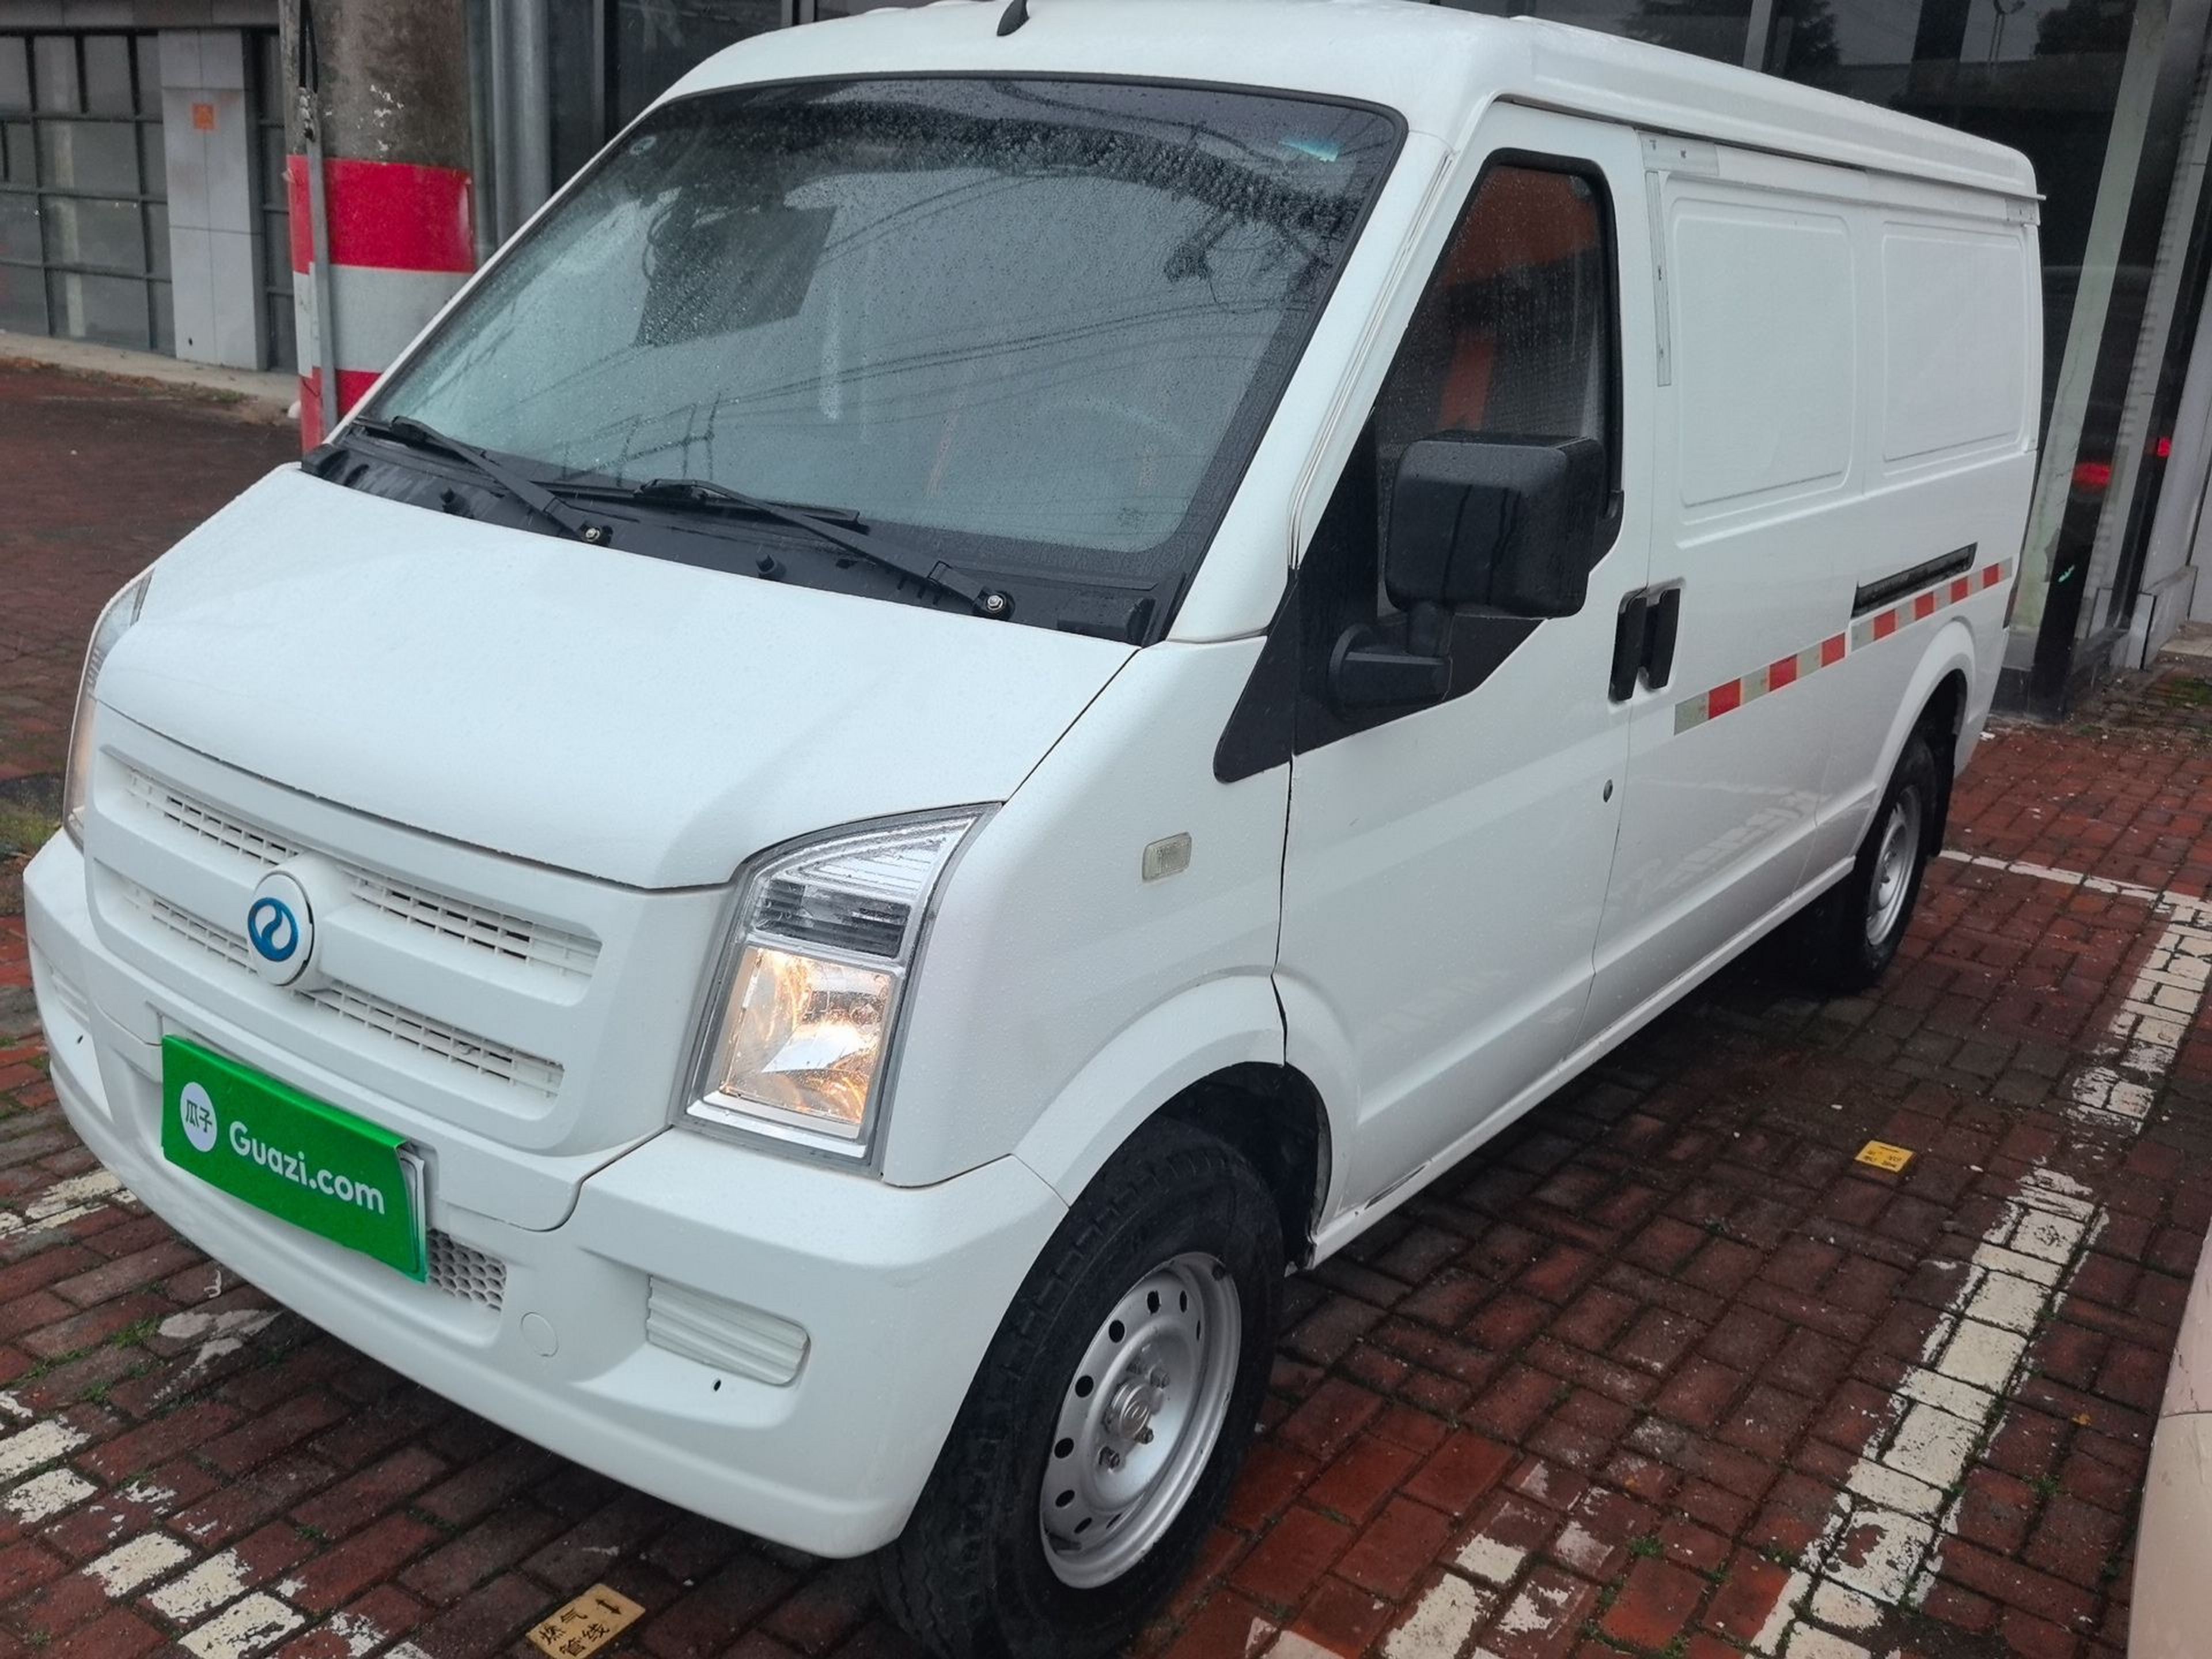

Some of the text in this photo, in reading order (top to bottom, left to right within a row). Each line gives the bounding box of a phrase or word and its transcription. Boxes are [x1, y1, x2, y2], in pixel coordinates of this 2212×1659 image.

[185, 1099, 213, 1132] 瓜子
[230, 1121, 385, 1215] Guazi.com
[539, 1608, 588, 1645] 燃气
[559, 1623, 610, 1657] 管线
